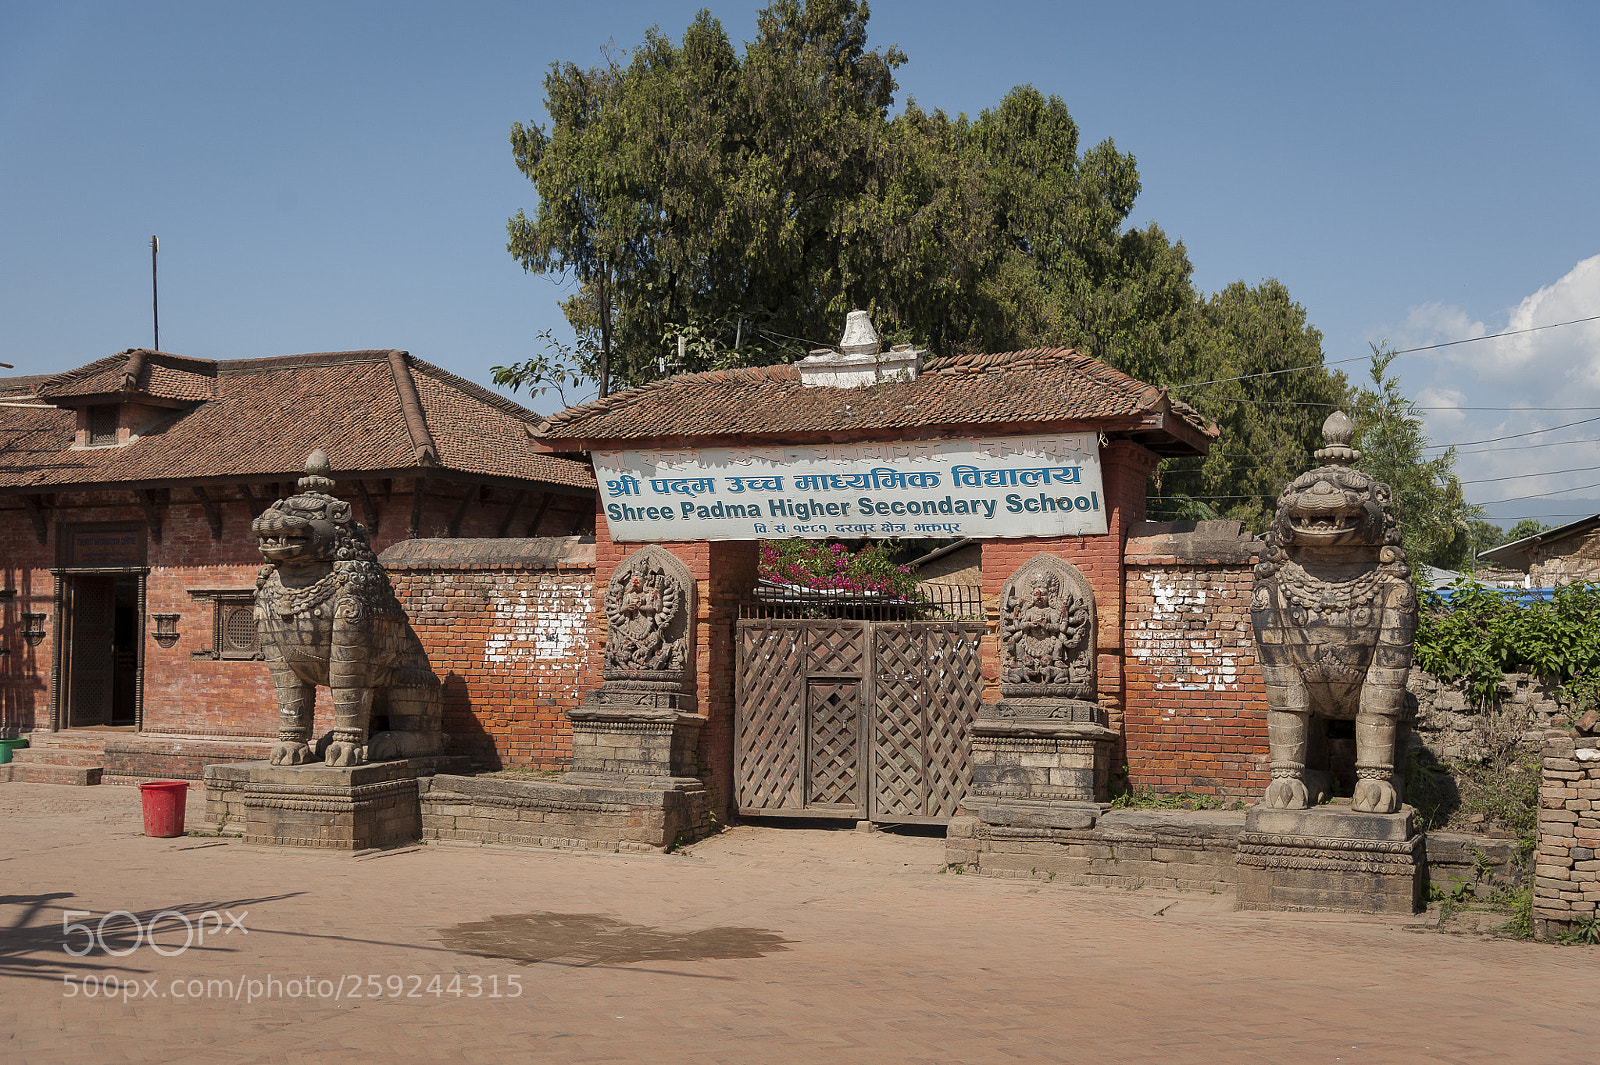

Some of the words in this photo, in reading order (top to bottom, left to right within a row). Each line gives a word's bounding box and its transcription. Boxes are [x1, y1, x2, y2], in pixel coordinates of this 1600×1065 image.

[606, 475, 640, 497] श्री
[725, 475, 784, 493] उच्च
[793, 467, 941, 490] माध्यमिक
[951, 465, 1082, 487] विद्यालय
[608, 503, 674, 520] Shree
[681, 501, 761, 518] Padma
[769, 498, 850, 520] Higher
[859, 495, 997, 519] Secondary
[1006, 492, 1099, 513] School
